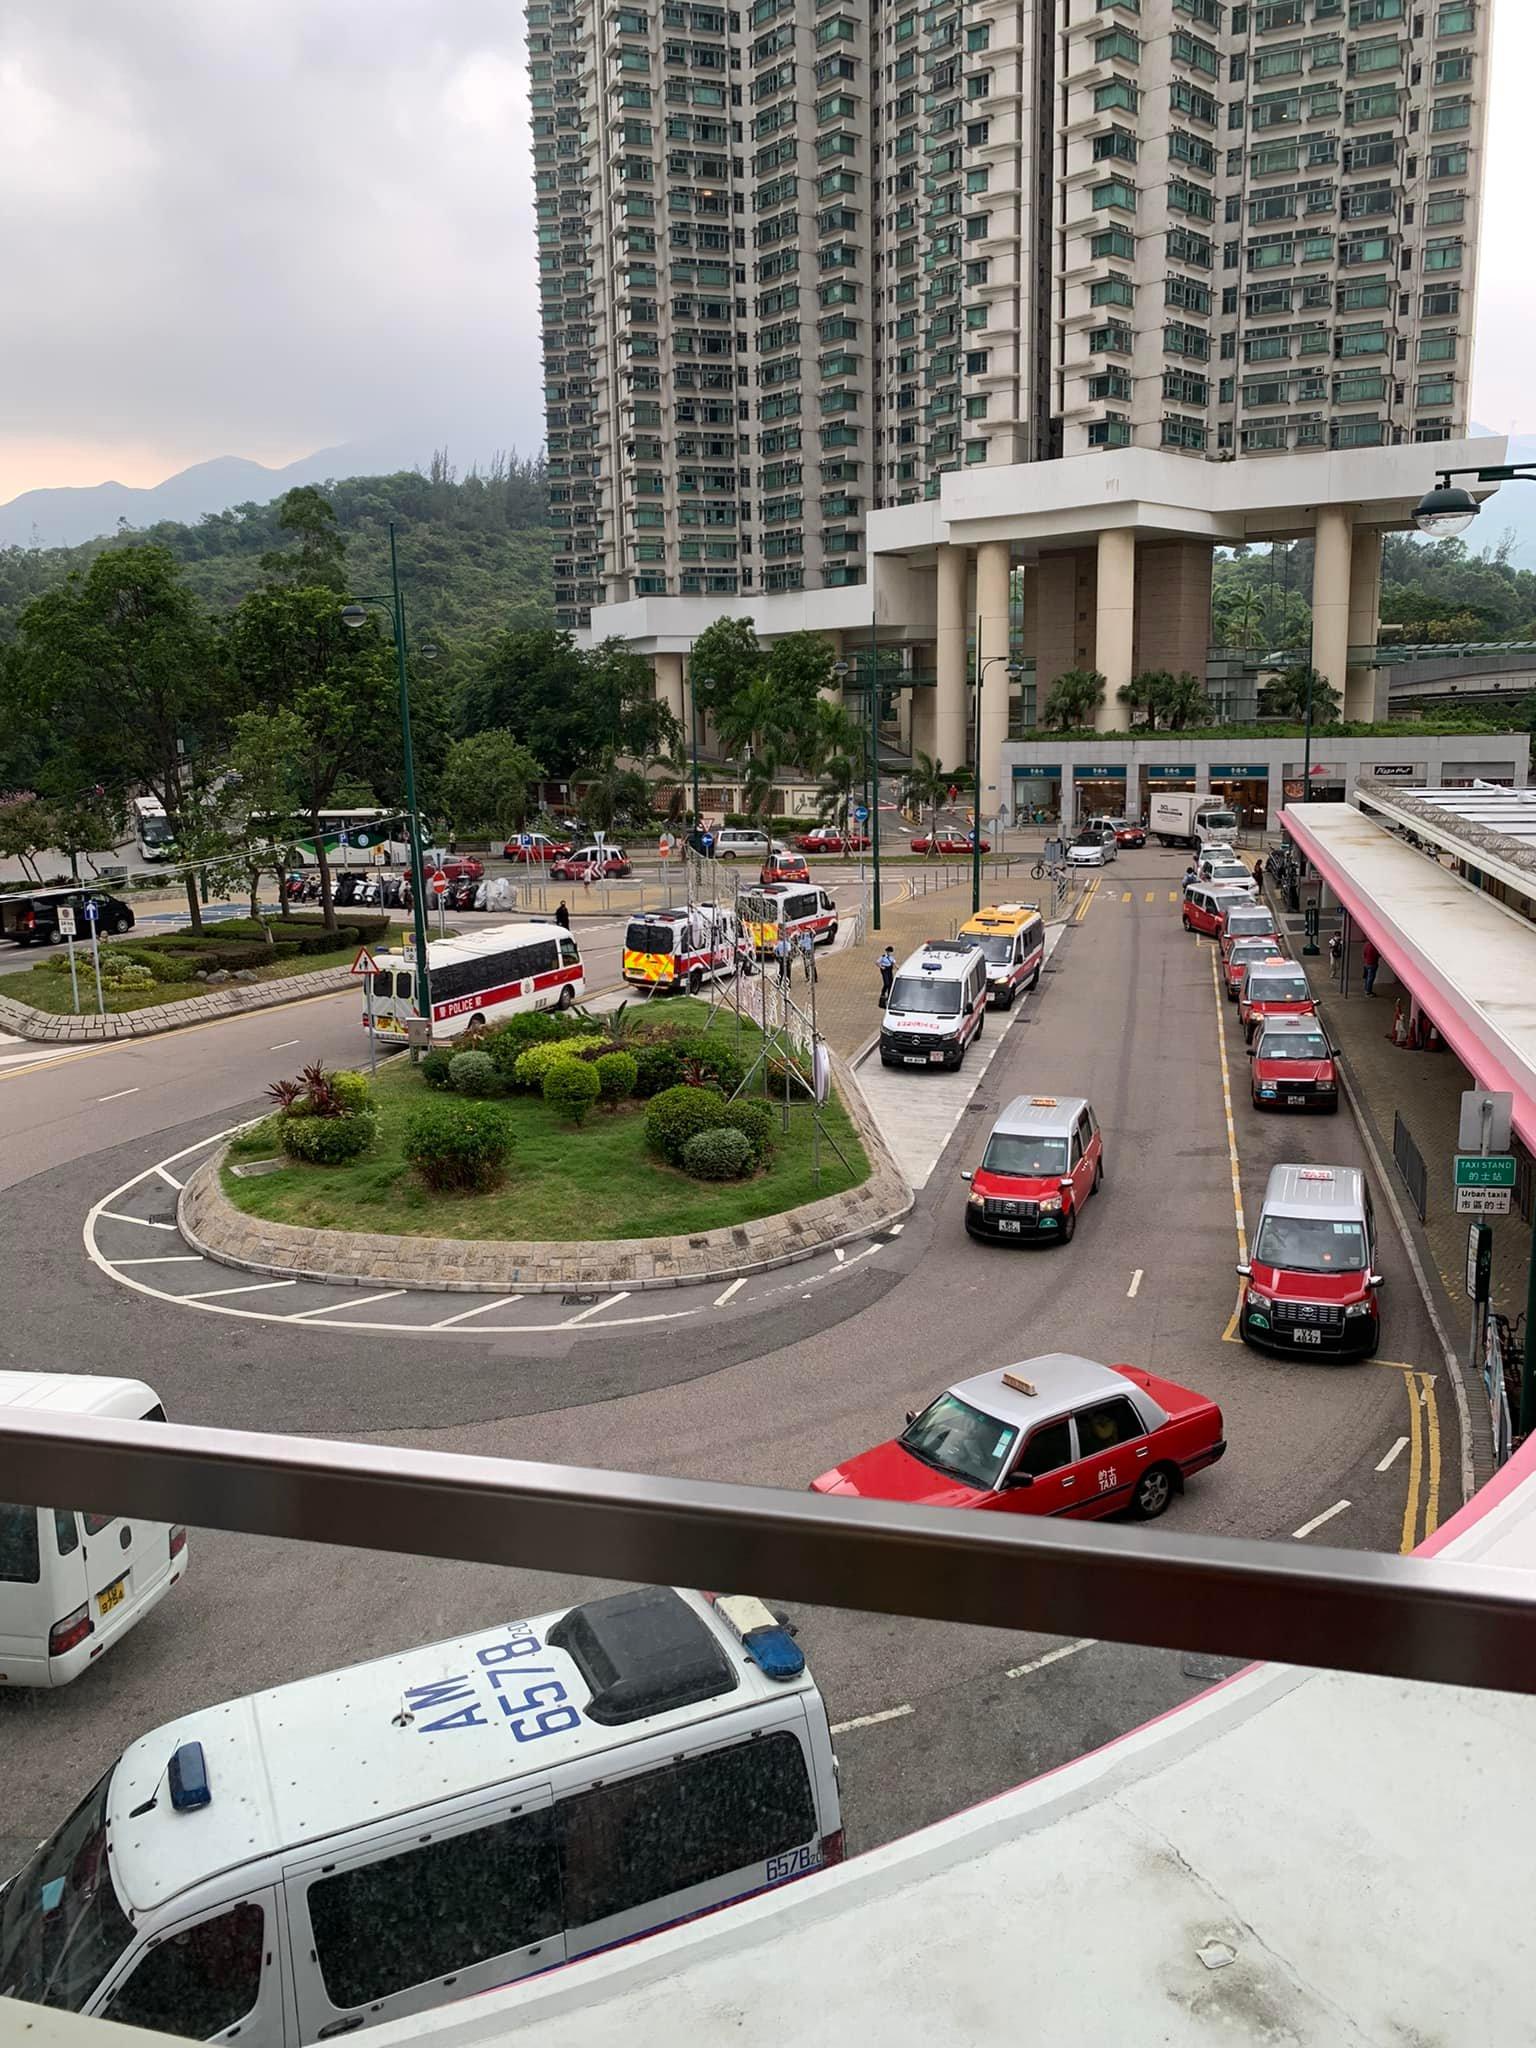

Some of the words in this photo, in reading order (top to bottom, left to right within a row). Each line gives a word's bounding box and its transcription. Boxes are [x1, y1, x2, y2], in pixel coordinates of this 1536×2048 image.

[449, 998, 473, 1015] POLICE
[1468, 1172, 1503, 1181] 的士站
[1462, 1190, 1486, 1198] Urban
[1488, 1190, 1508, 1198] taxis
[1461, 1200, 1506, 1210] 市區的士
[1098, 1466, 1117, 1481] 的士
[1099, 1474, 1117, 1491] TAXI
[476, 1636, 581, 1743] 6578
[404, 1674, 488, 1733] AM
[766, 1846, 810, 1881] 6578
